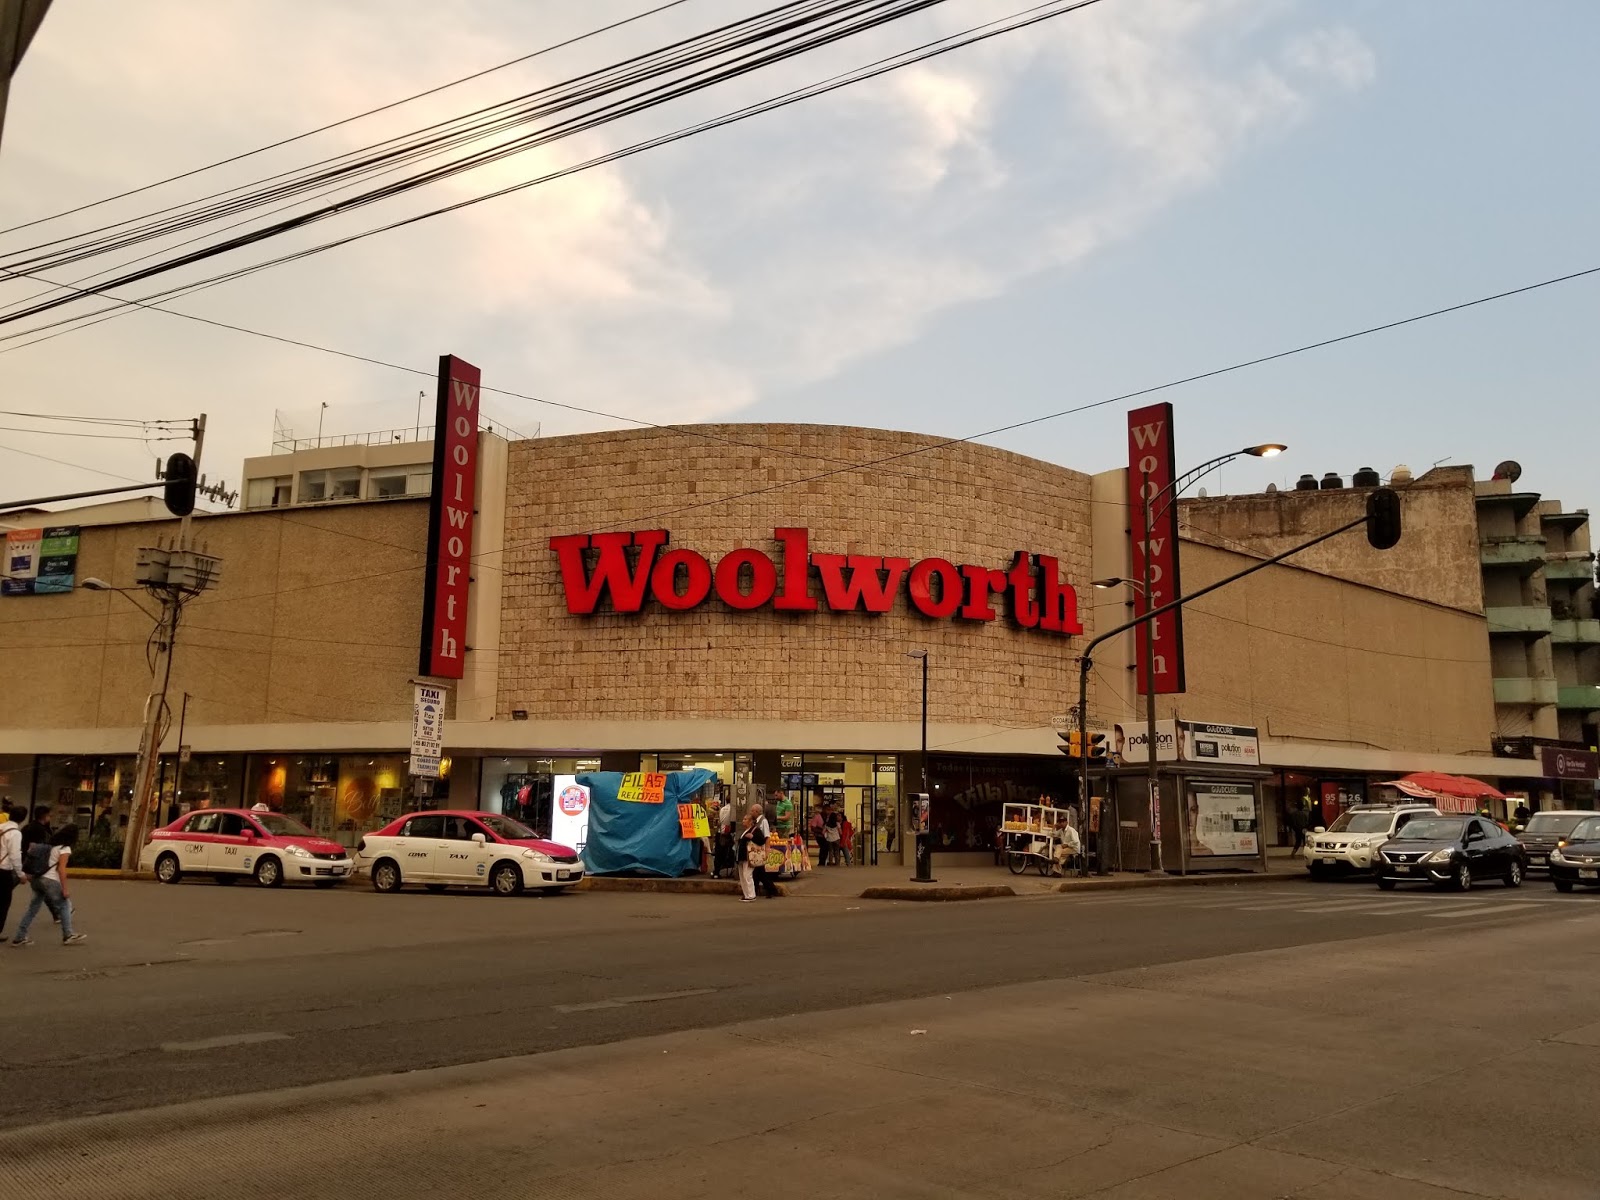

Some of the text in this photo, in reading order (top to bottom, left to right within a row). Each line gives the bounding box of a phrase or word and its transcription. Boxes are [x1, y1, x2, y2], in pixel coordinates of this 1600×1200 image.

[440, 376, 478, 659] Woolworth
[549, 526, 1084, 637] Woolworth
[420, 688, 440, 699] TAXI
[1129, 731, 1173, 752] pollion
[621, 773, 664, 788] PILAS
[1324, 793, 1336, 802] 95
[680, 804, 707, 820] PILAS
[225, 846, 238, 855] TAXI
